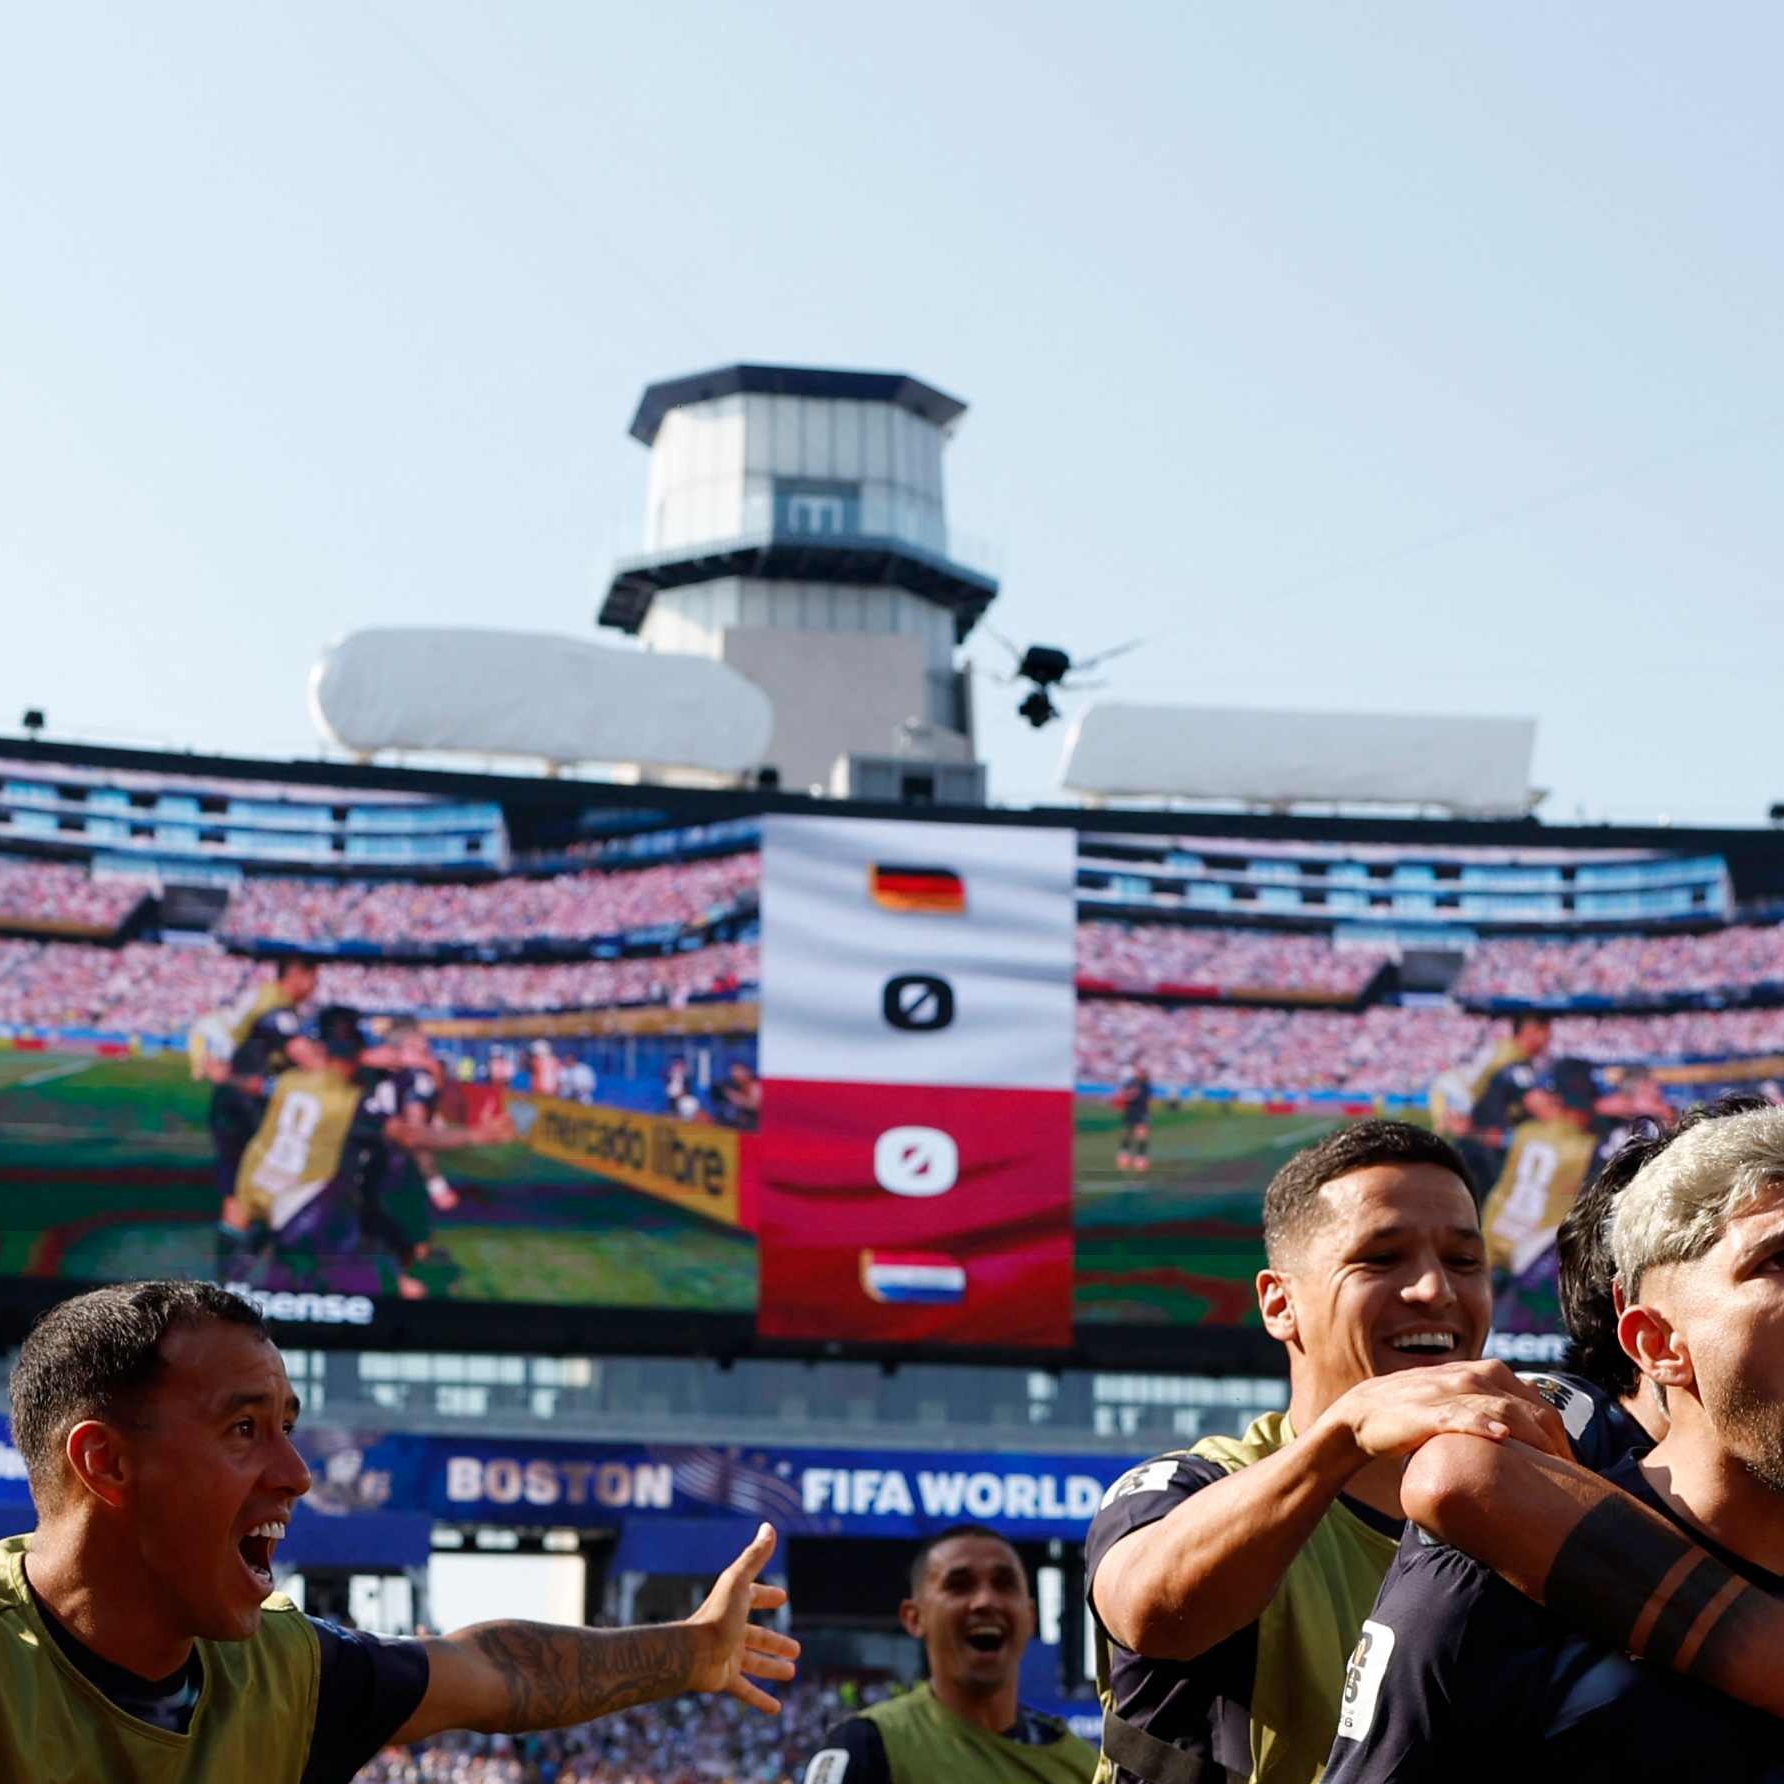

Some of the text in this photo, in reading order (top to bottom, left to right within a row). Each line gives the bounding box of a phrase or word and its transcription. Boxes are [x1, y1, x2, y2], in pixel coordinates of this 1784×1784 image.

[446, 1456, 1105, 1520] BOSTON FIFA WORLD
